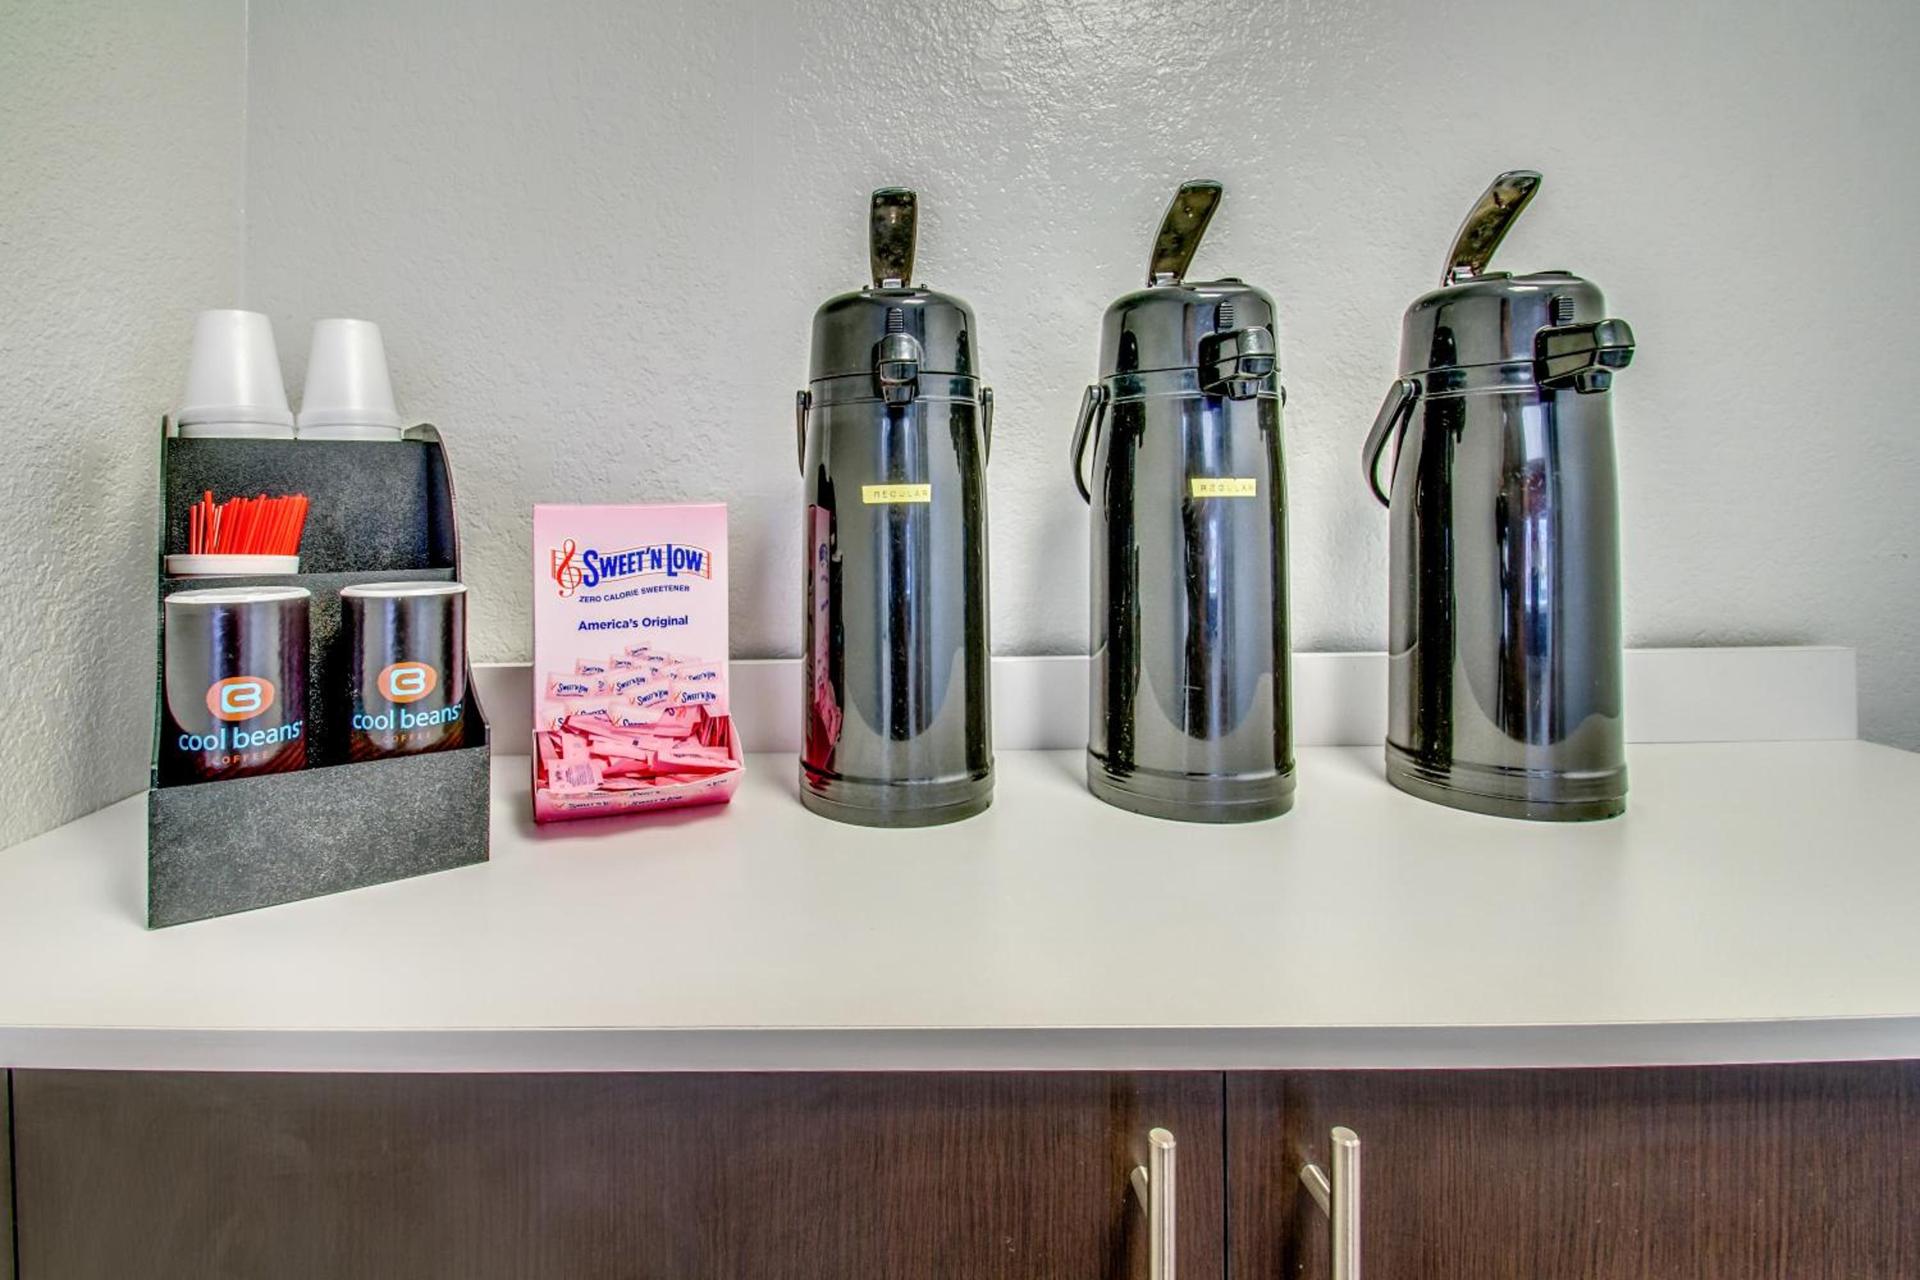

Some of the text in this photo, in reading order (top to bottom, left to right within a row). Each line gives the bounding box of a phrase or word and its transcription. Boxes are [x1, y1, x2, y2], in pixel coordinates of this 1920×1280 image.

[582, 543, 703, 588] SWEET'N LOW
[579, 584, 690, 603] ZERO CALORIE SWEETENER
[578, 615, 689, 631] America's Original
[352, 704, 460, 731] cool beans
[178, 721, 301, 751] cool beans
